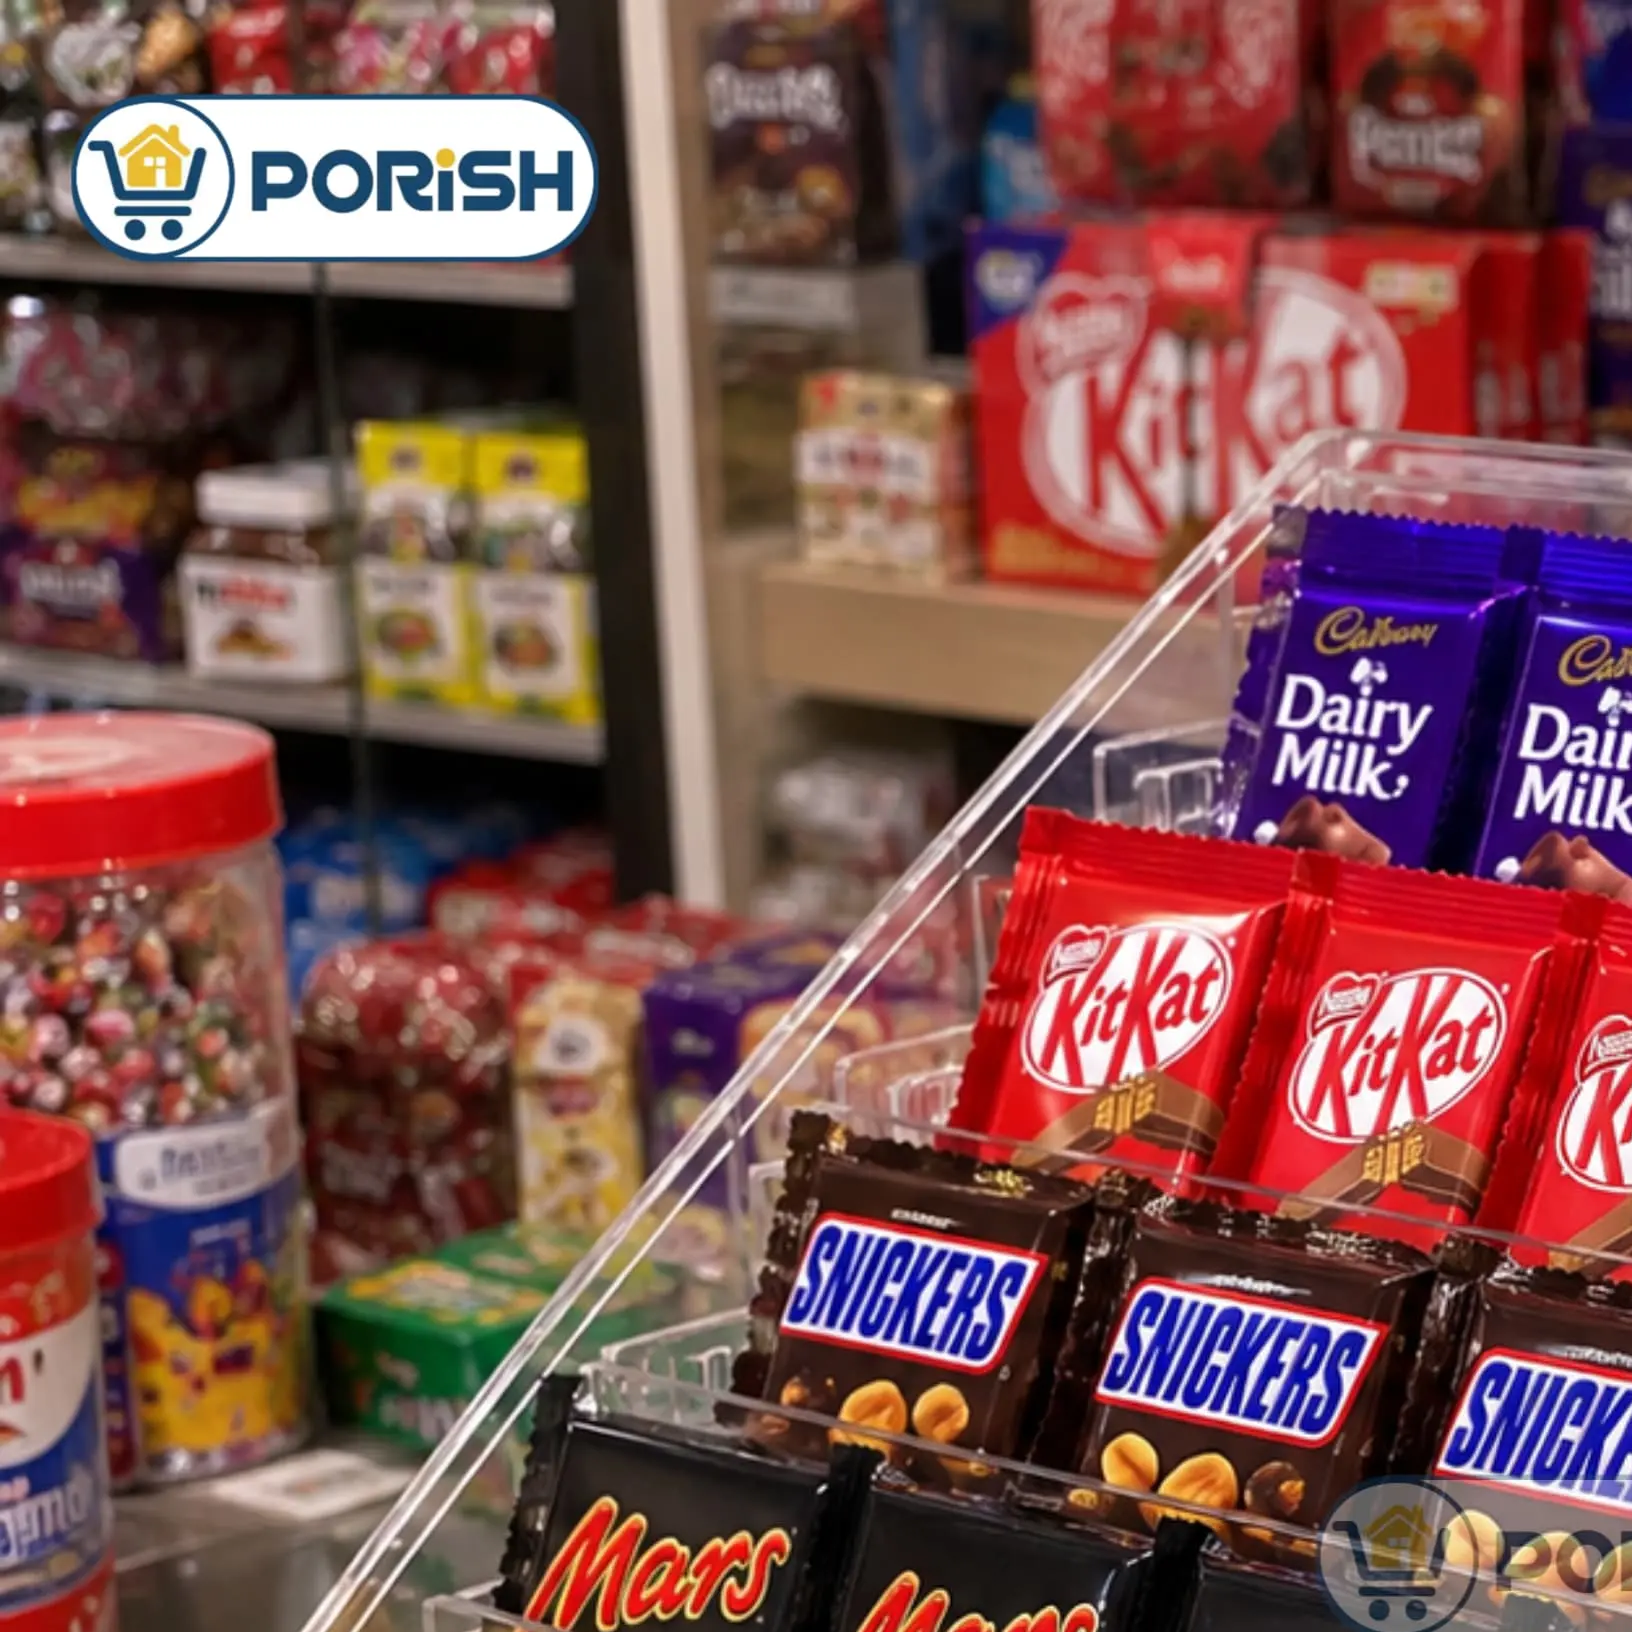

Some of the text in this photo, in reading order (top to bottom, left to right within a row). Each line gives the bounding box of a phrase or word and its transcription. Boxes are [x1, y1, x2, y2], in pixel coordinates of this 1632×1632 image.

[1271, 733, 1409, 801] Milk
[1275, 672, 1433, 755] Dairy
[786, 1225, 1031, 1361] SNICKERS
[1102, 1290, 1368, 1434] SNICKERS
